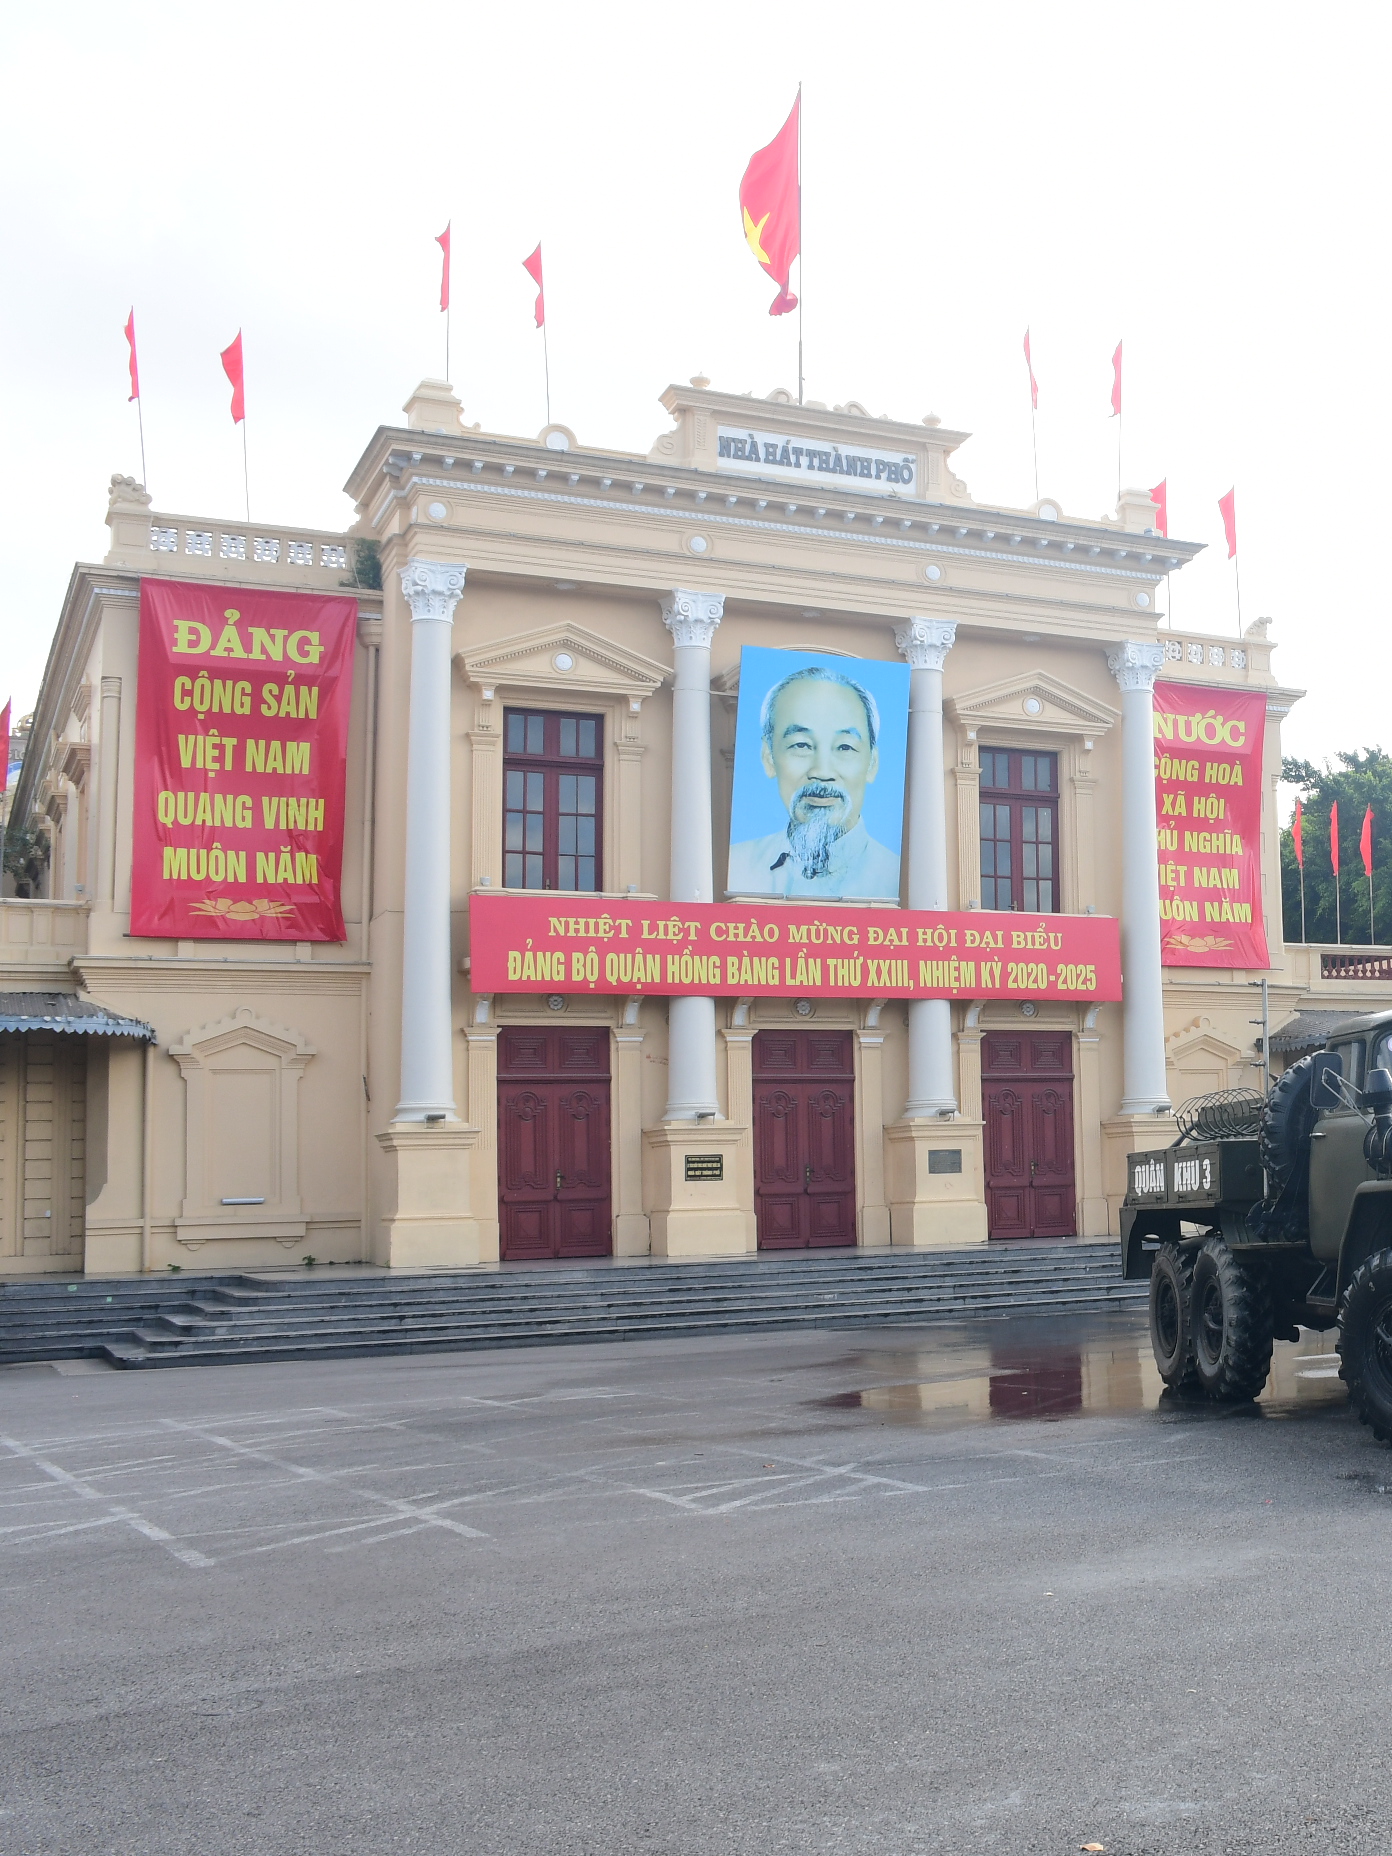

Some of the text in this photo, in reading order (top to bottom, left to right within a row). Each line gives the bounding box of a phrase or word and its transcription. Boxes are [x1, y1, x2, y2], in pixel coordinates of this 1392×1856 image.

[718, 433, 917, 485] NHÀ HÁT THÀNH PHỐ
[172, 608, 324, 664] ĐẢNG
[174, 670, 319, 720] CỘNG SẢN
[1153, 709, 1246, 747] NƯỚC
[178, 729, 310, 778] VIỆT NAM
[1205, 760, 1243, 786] HOÀ
[157, 790, 325, 831] QUANG VINH
[1161, 790, 1225, 824] XÃ HỘI
[1156, 820, 1243, 856] HỦ NGHĨA
[163, 842, 318, 885] MUÔN NĂM
[1157, 860, 1240, 891] IỆT NAM
[1159, 895, 1252, 924] UÔN NĂM
[548, 913, 1063, 952] NHIỆT LIỆT CHÀO MỪNG ĐẠI HỘI ĐẠI BIỂU
[508, 938, 565, 982] ĐẢNG
[571, 945, 599, 989] BỘ
[605, 947, 661, 989] QUẬN
[666, 945, 721, 985] HỒNG
[727, 950, 779, 986] BÀNG
[785, 947, 822, 986] LẦN
[826, 951, 864, 987] THỨ
[867, 958, 914, 991] XXIII,
[919, 955, 976, 994] NHIỆM
[981, 956, 1002, 989] KỲ
[1134, 1158, 1211, 1197] QUÂN KHU 3
